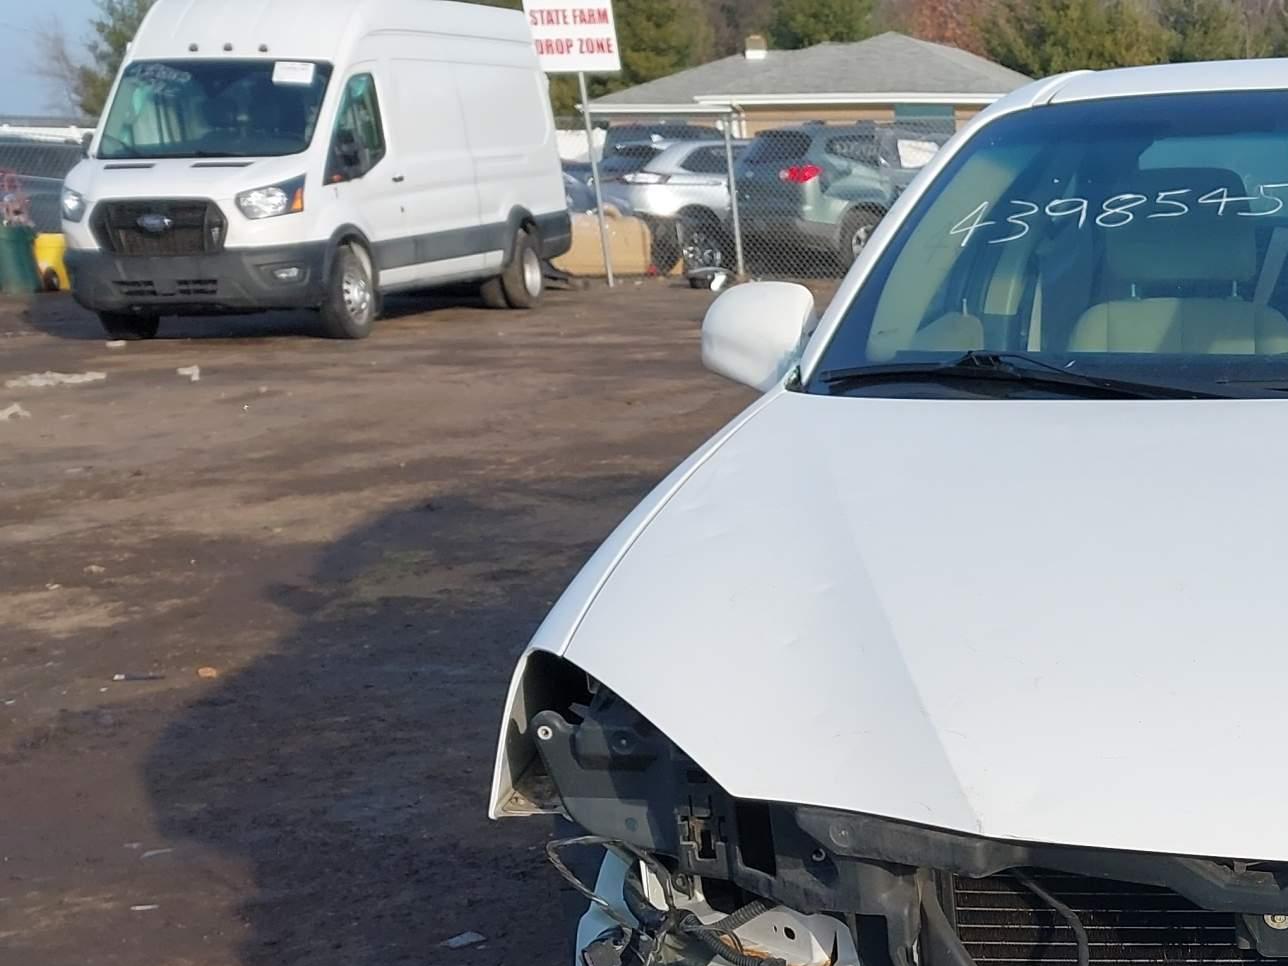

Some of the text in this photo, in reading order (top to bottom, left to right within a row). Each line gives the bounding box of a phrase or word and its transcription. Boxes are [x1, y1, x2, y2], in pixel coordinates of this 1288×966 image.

[529, 8, 609, 26] STATE FARM
[534, 38, 614, 55] DROP ZONE
